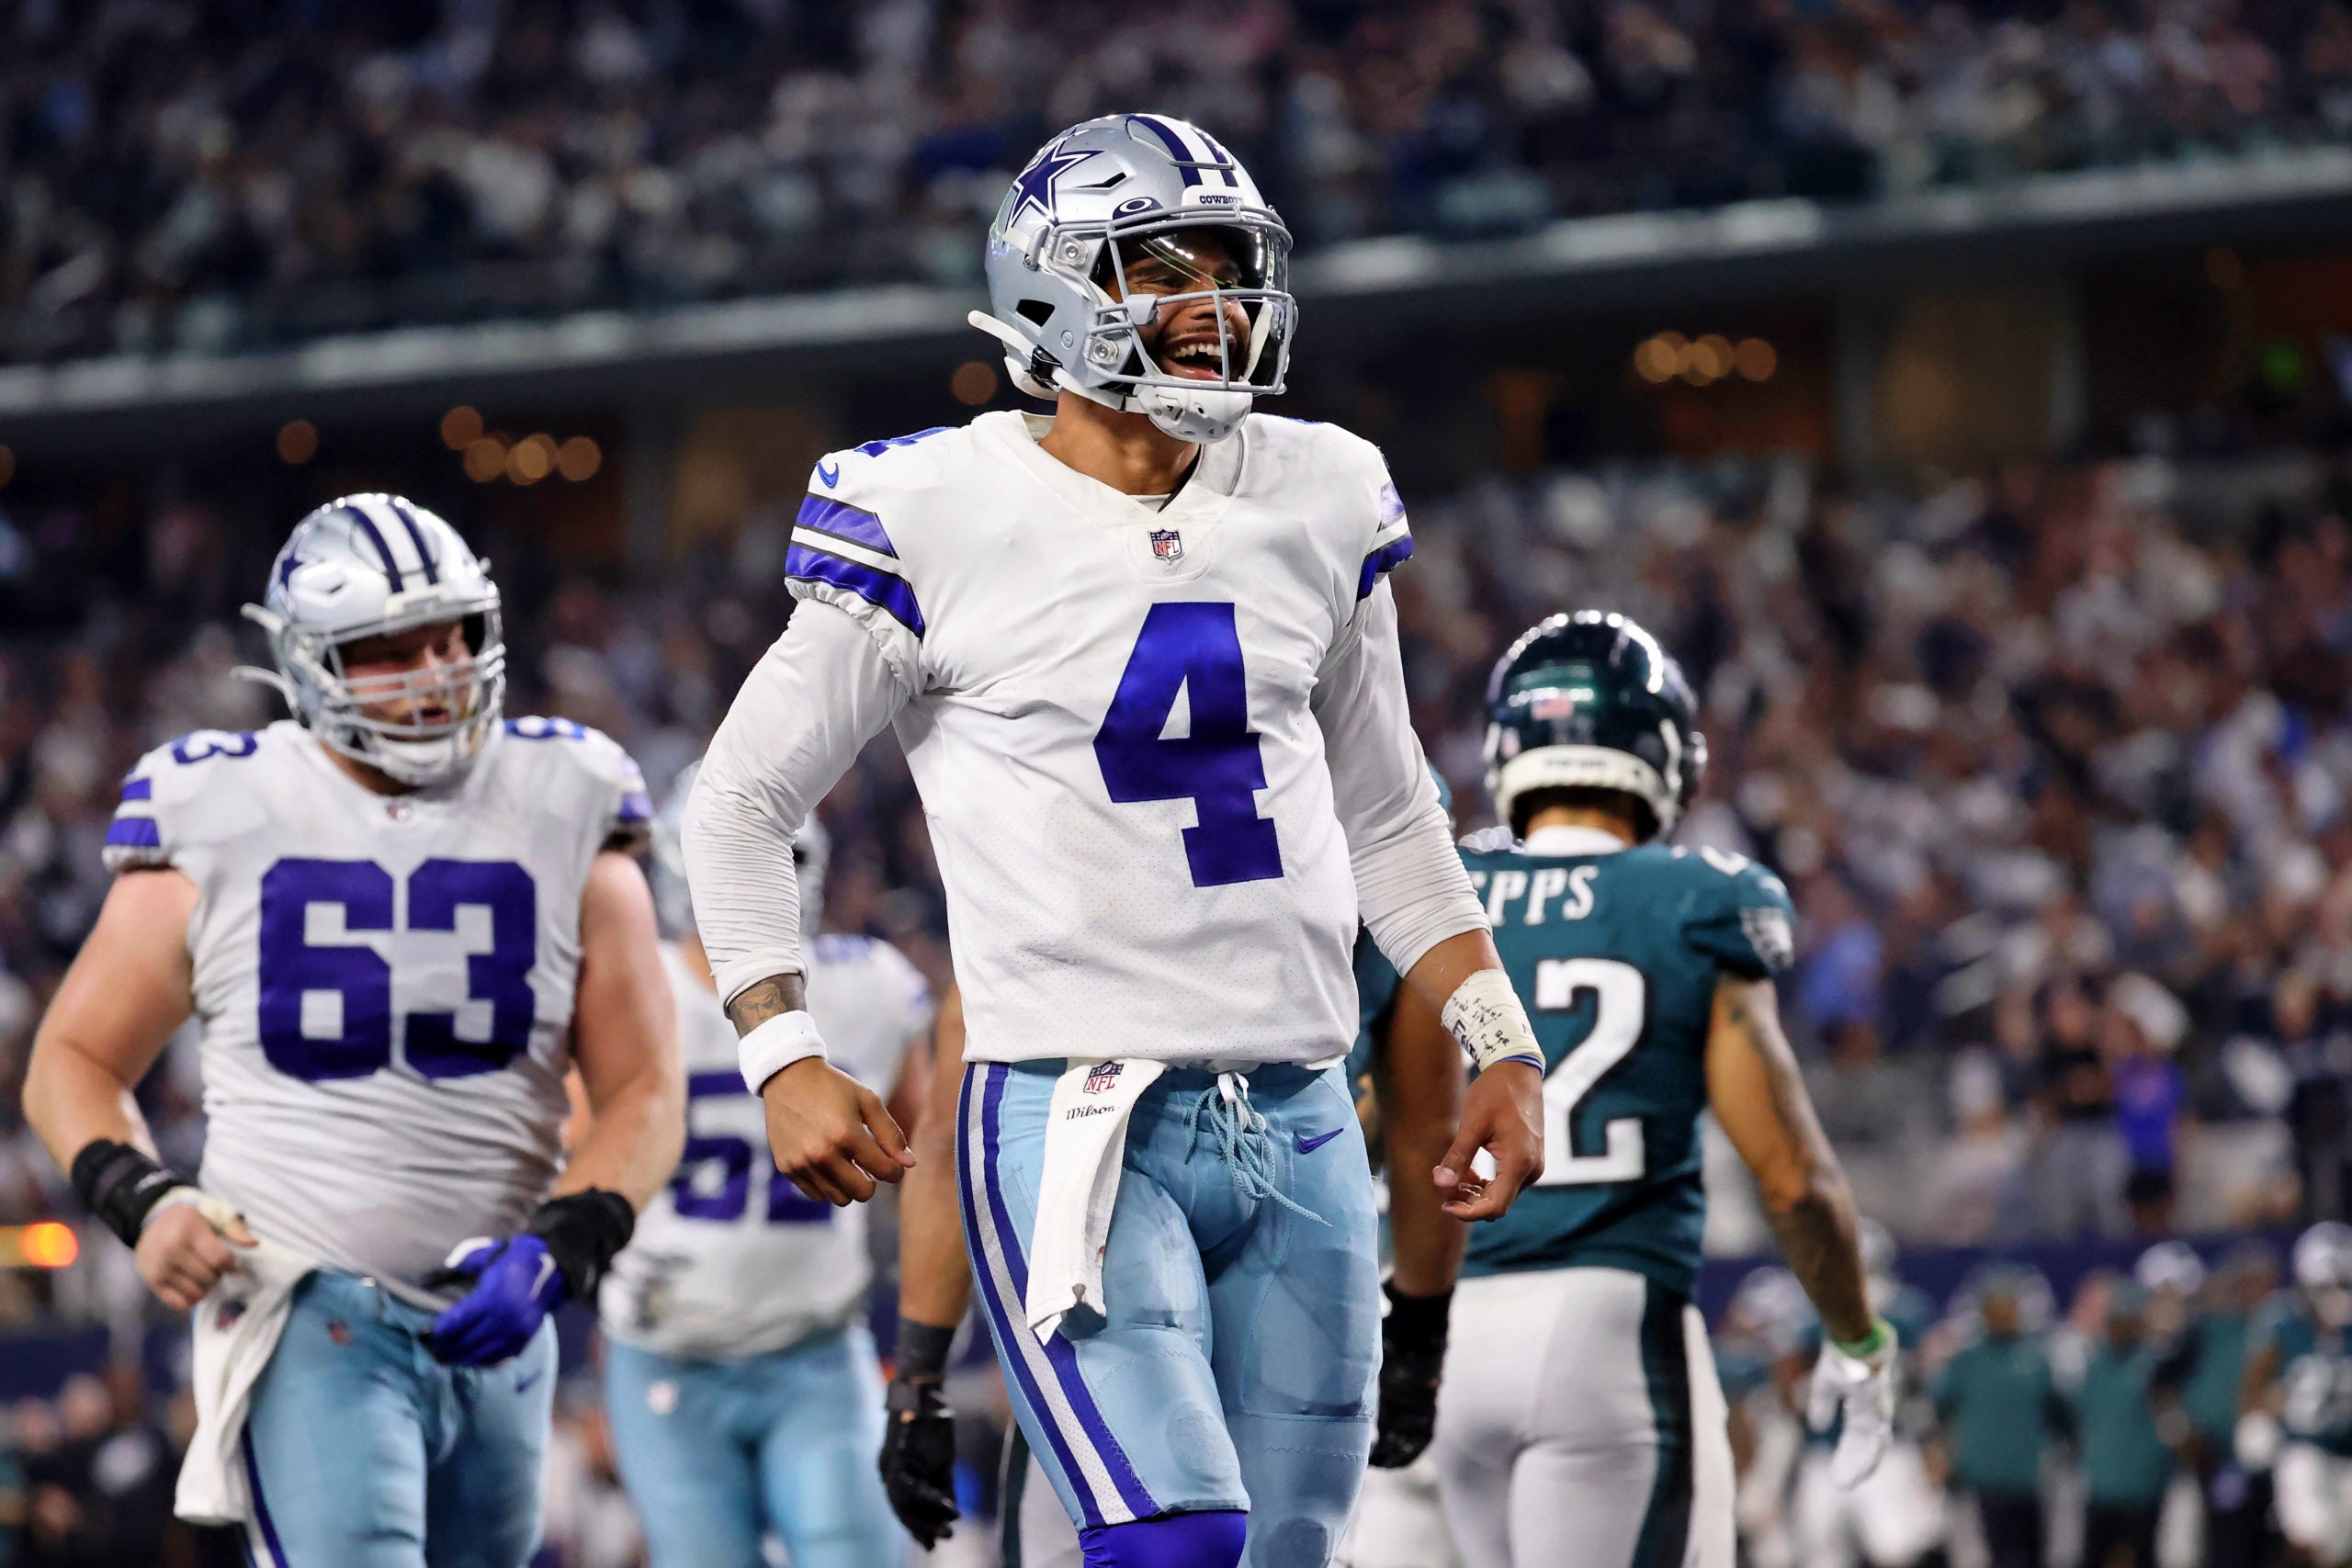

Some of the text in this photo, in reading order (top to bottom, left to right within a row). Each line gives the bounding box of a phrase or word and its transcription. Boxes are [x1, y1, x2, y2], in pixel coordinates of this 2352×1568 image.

[1155, 541, 1179, 556] NFL
[1093, 602, 1283, 887] 4
[1467, 864, 1600, 927] PPS
[259, 857, 537, 1081] 63
[1086, 1075, 1116, 1092] NFL
[1066, 1104, 1115, 1121] Wilson
